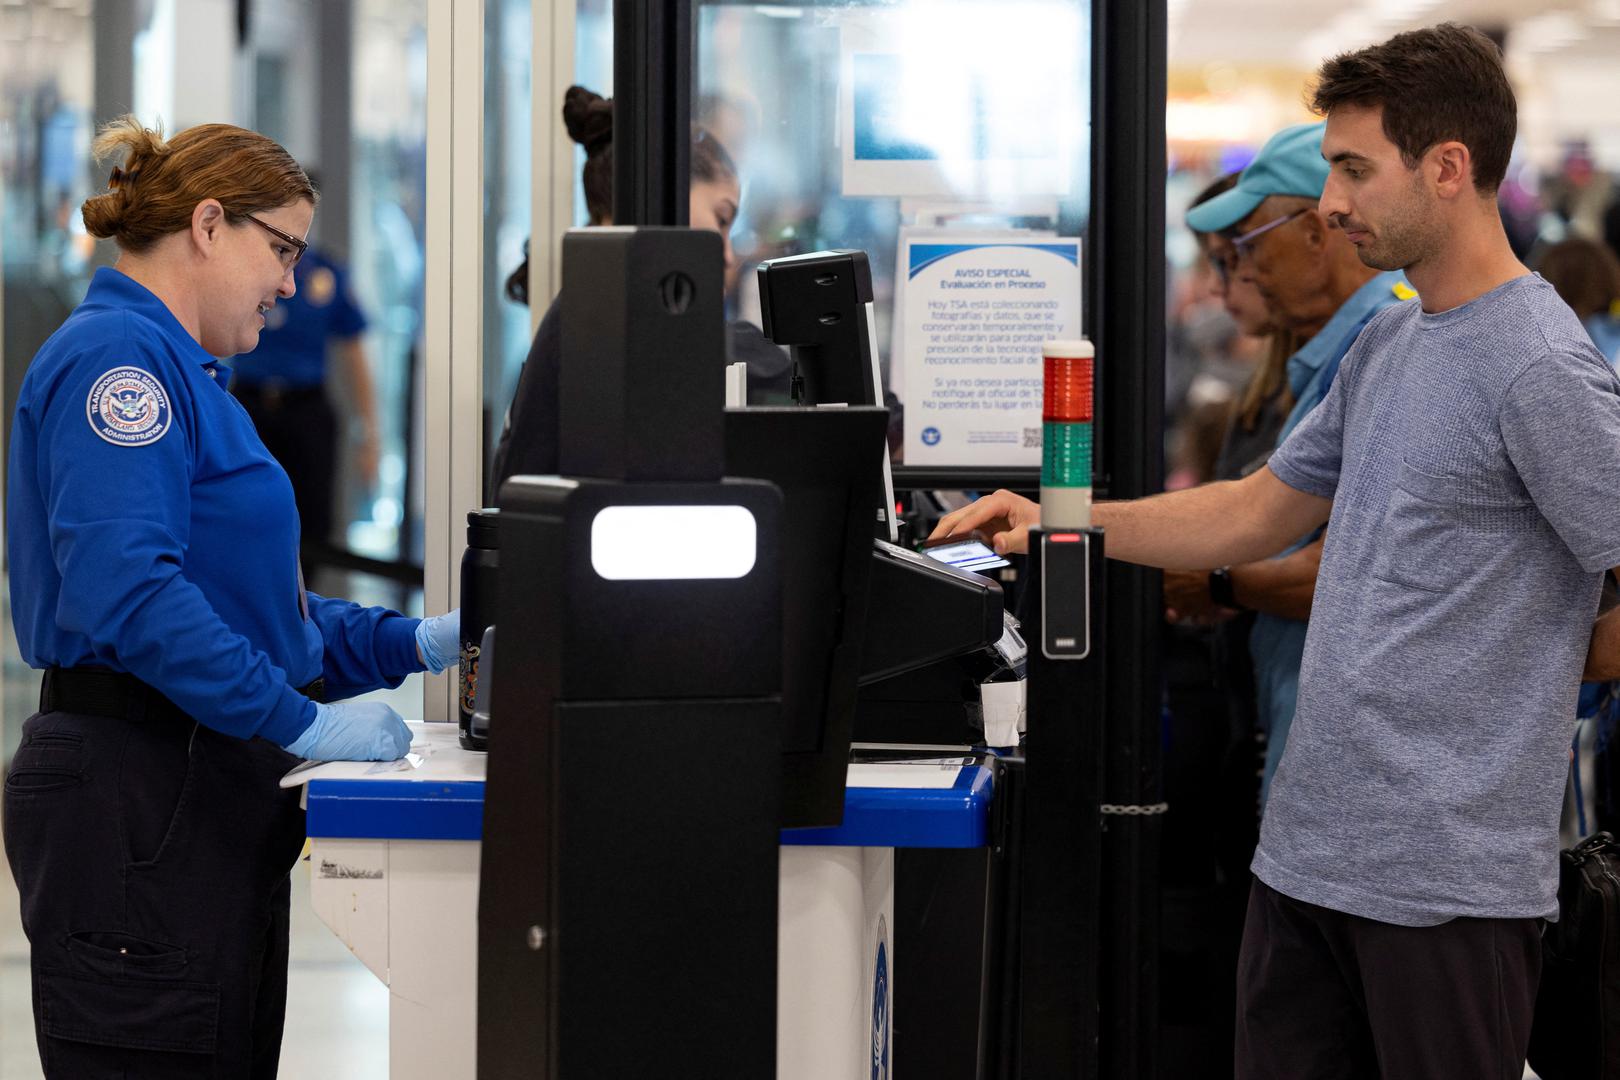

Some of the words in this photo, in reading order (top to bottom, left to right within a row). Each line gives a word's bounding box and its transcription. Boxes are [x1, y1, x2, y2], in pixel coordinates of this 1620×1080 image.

[954, 269, 984, 278] AVISO
[986, 269, 1032, 278] ESPECIAL
[940, 279, 992, 289] Evaluación
[994, 281, 1005, 289] en
[1008, 280, 1046, 289] Proceso
[928, 300, 947, 310] Hoy
[950, 300, 967, 309] TSA
[970, 300, 989, 309] está
[991, 300, 1058, 309] coleccionando
[984, 313, 991, 321] y
[1023, 313, 1041, 321] que
[982, 322, 1054, 332] temporalmente
[1056, 324, 1064, 332] y
[989, 335, 1011, 343] para
[1012, 333, 1045, 343] probar
[926, 344, 969, 354] precisión
[971, 344, 984, 353] de
[986, 344, 995, 353] la
[924, 356, 997, 365] reconocimiento
[999, 355, 1024, 365] facial
[1026, 355, 1038, 365] de
[934, 377, 943, 387] Si
[945, 379, 957, 388] ya
[974, 377, 1002, 386] desea
[91, 371, 141, 414] TRANSPORTATION
[142, 376, 166, 409] SECURITY
[932, 388, 975, 398] notifique
[977, 388, 985, 397] al
[987, 388, 1016, 397] oficial
[1018, 388, 1031, 397] de
[922, 400, 936, 408] No
[982, 400, 992, 408] tu
[994, 399, 1017, 410] lugar
[102, 423, 163, 441] ADMINISTRATION
